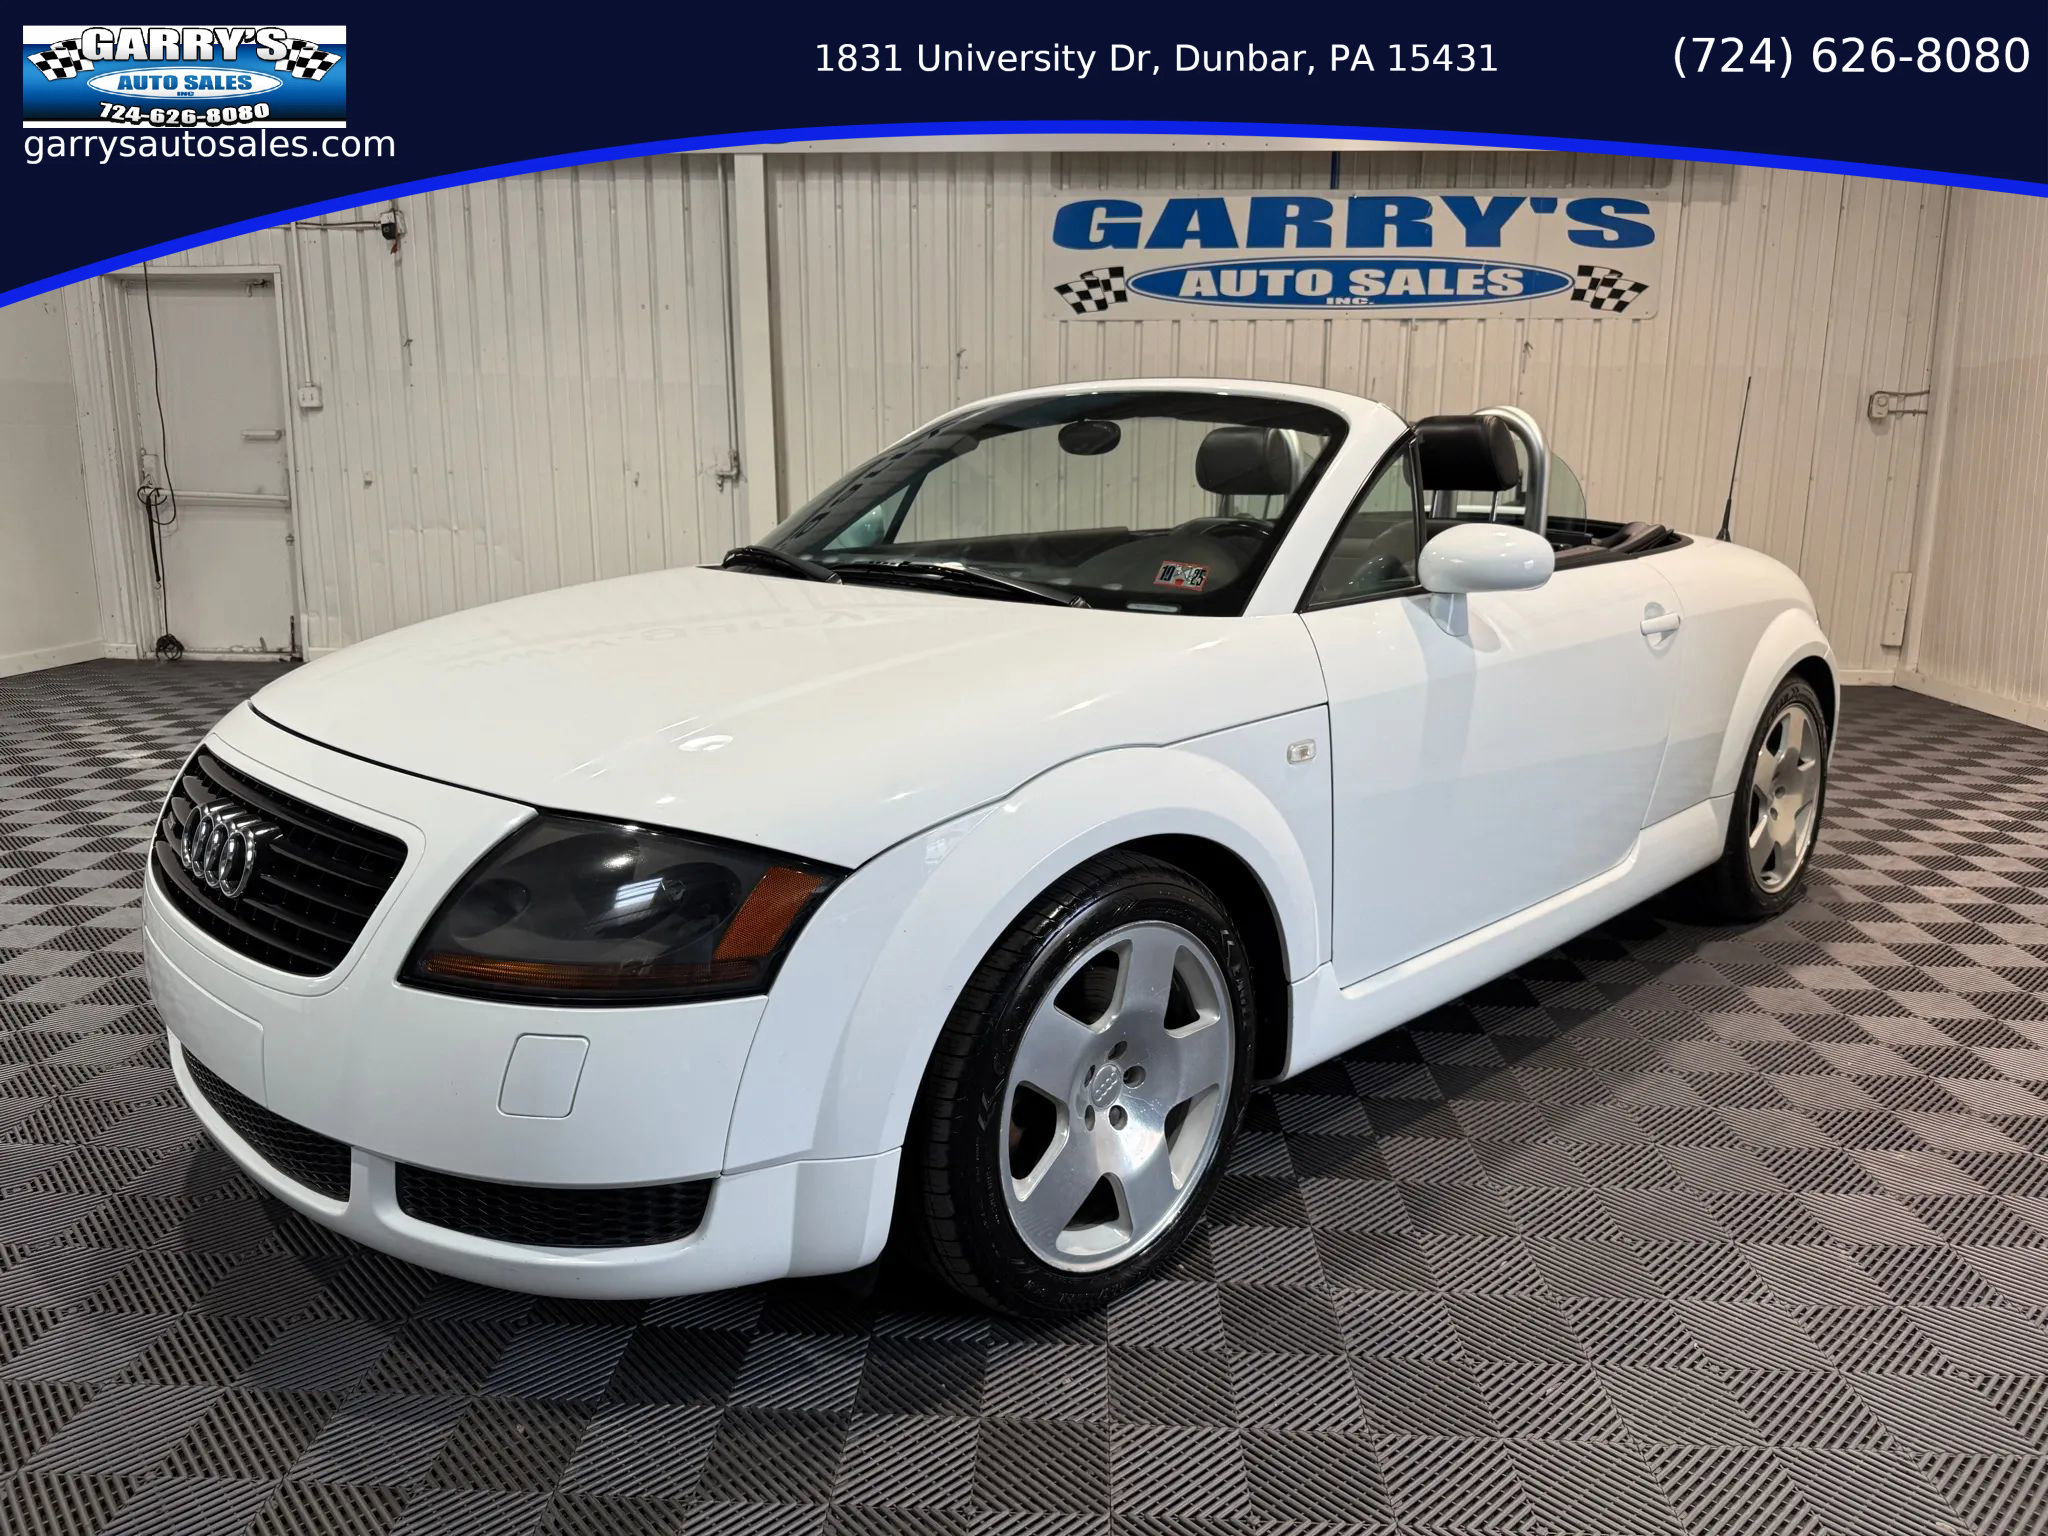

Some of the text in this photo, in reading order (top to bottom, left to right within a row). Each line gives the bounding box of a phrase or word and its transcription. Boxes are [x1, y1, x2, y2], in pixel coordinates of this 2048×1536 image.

[1052, 196, 1656, 250] GARRY'S
[1178, 268, 1524, 297] AUTO SALES
[1326, 296, 1375, 305] INC.
[1190, 567, 1207, 586] 25
